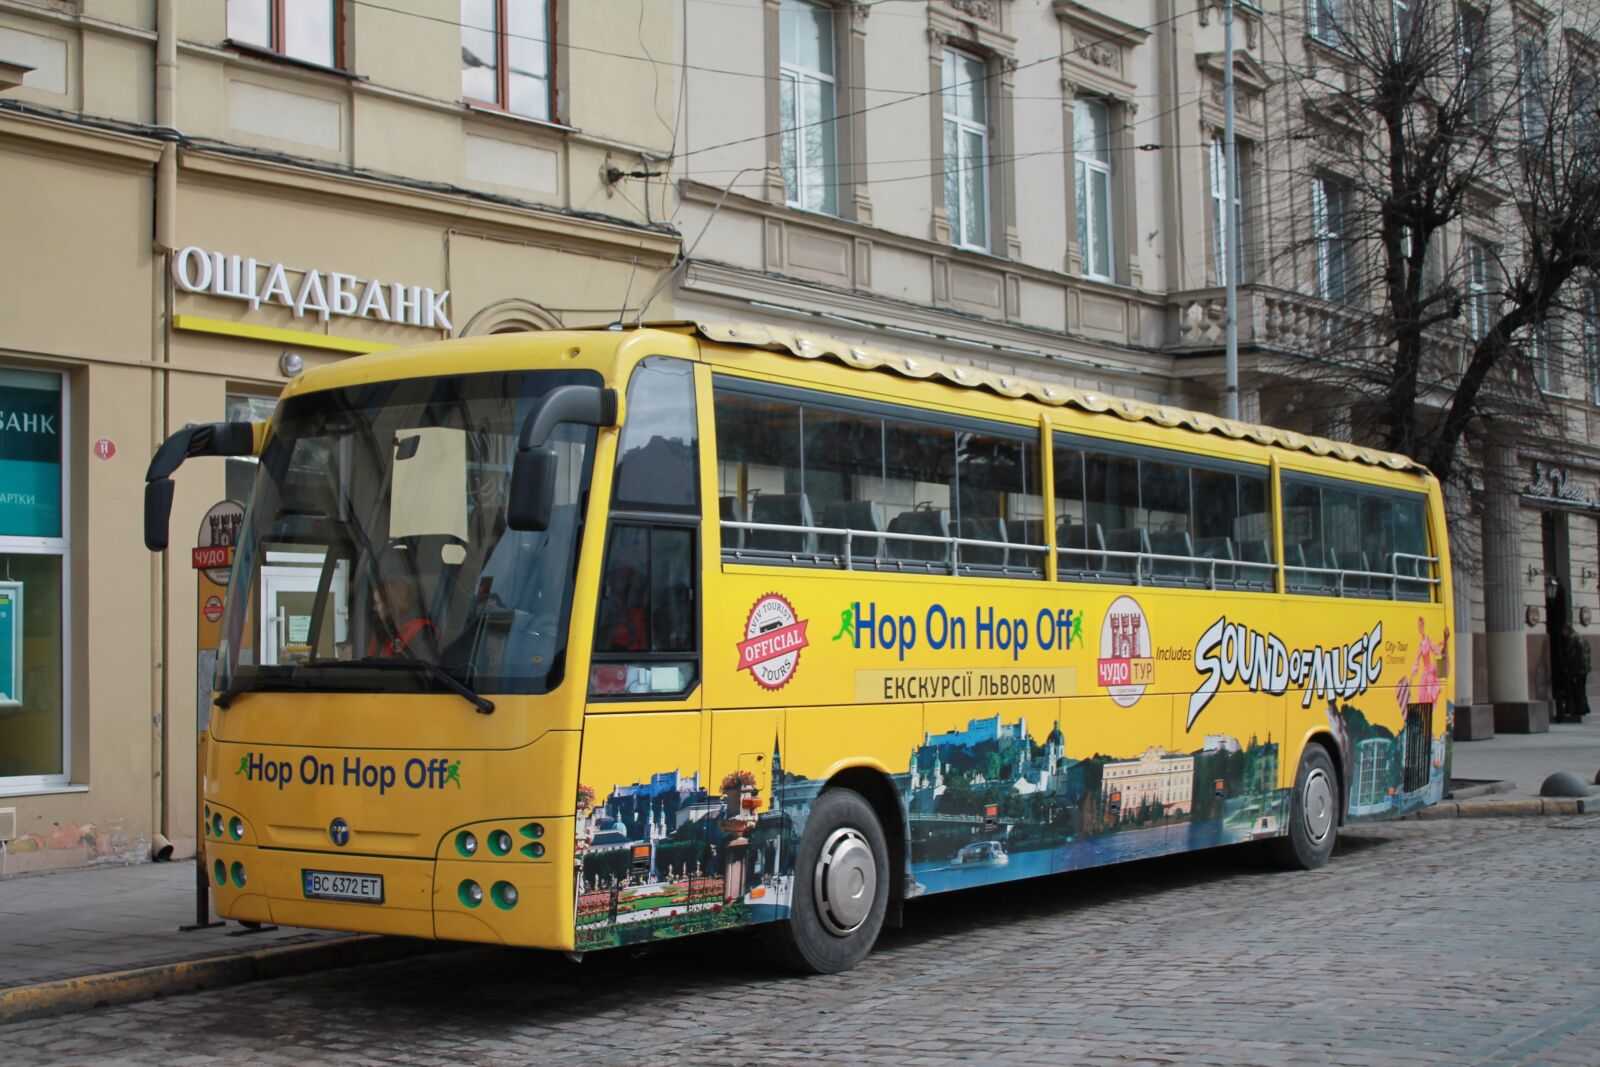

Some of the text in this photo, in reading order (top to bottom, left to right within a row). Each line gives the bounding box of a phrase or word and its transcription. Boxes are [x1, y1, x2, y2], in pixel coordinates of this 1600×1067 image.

[172, 246, 452, 330] ОЩАДБАНК
[195, 550, 225, 566] ЧУДО
[750, 602, 792, 634] LVIV TOURIST
[854, 601, 1073, 661] Hop On Hop Off
[745, 629, 802, 662] OFFICIAL
[762, 659, 791, 680] TOURS
[884, 671, 1055, 699] ЕКСКУРСІЇ ЛЬВОВОМ
[1100, 662, 1152, 684] ЧУДО ТУР
[1186, 615, 1289, 733] SOUND
[1289, 649, 1313, 689] OF
[249, 753, 449, 795] Hop On Hop Off
[313, 876, 378, 895] BC 6372 ET
